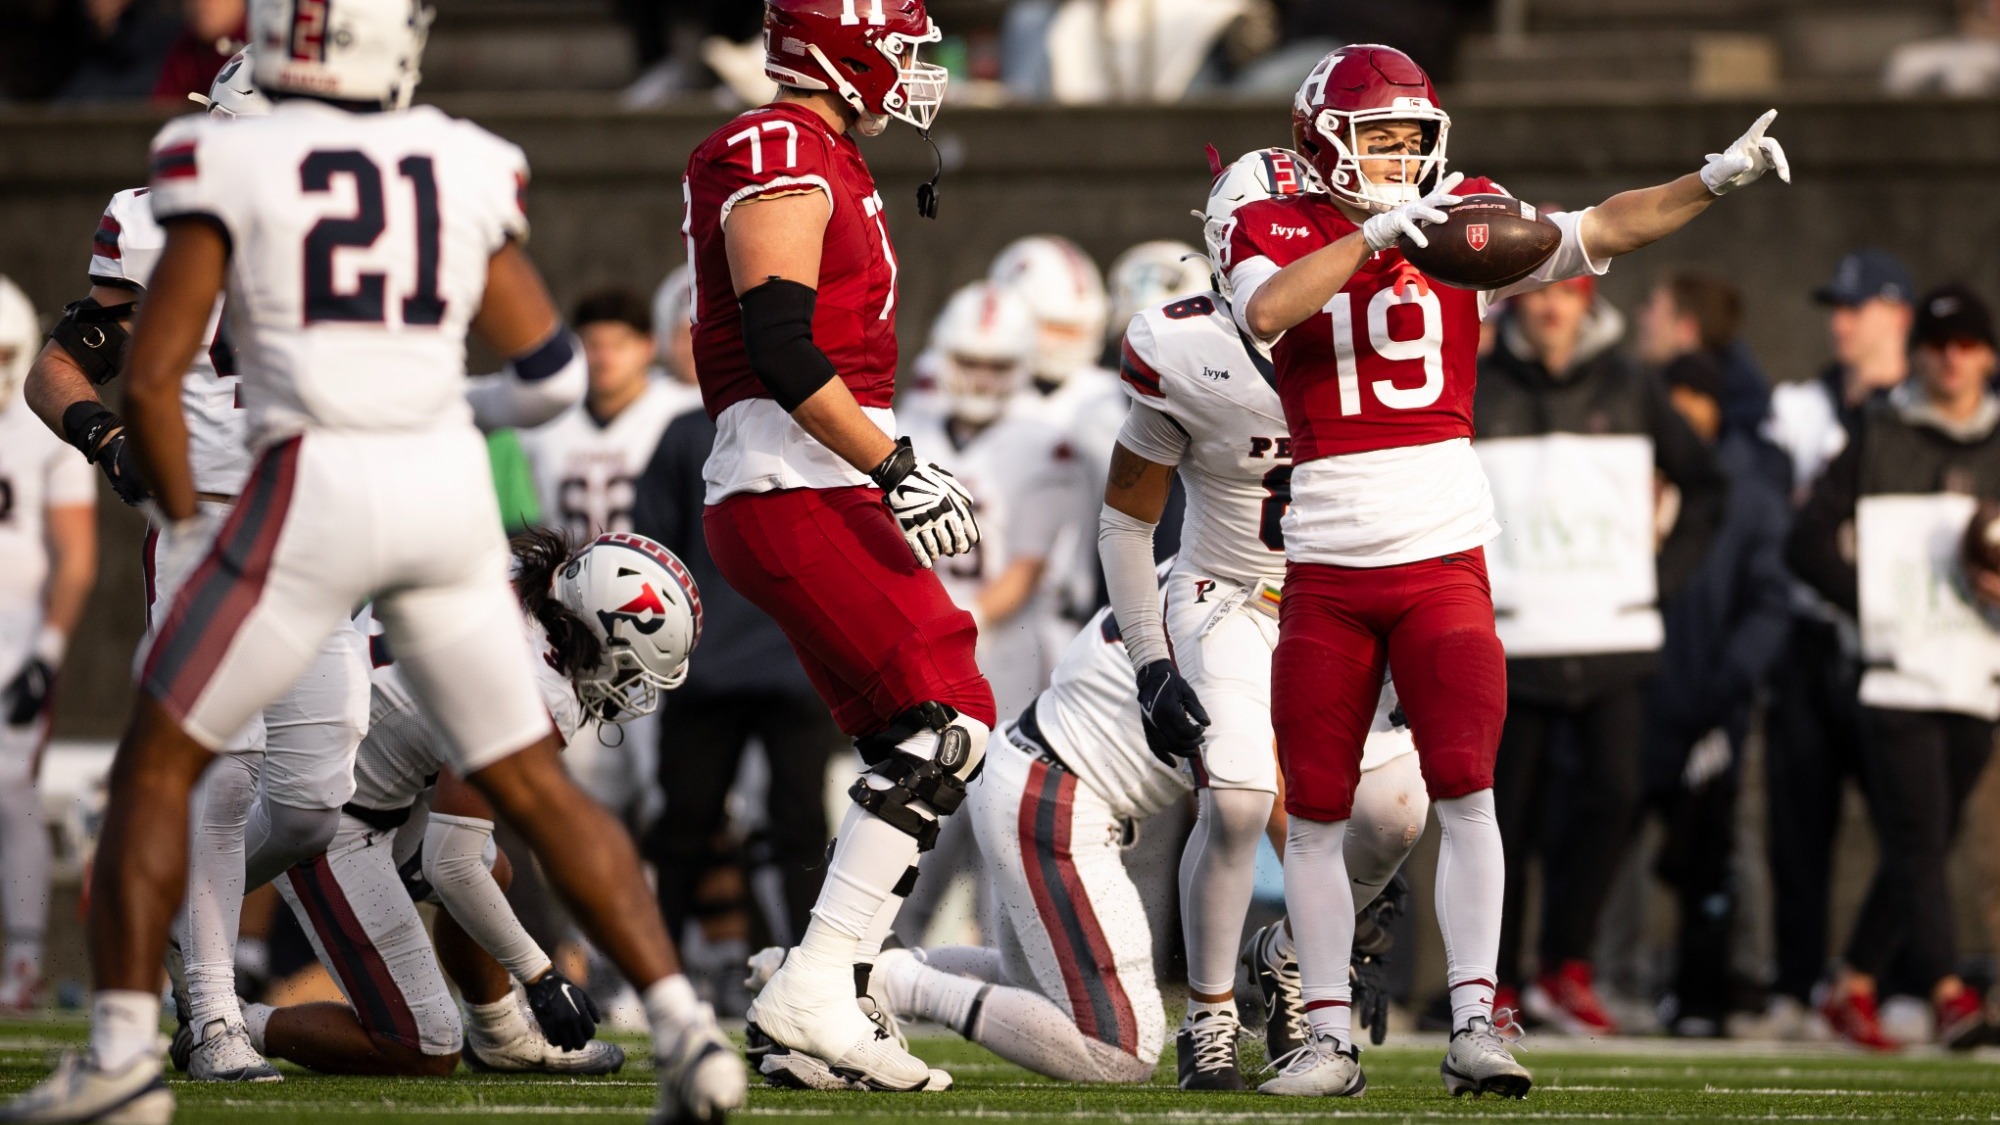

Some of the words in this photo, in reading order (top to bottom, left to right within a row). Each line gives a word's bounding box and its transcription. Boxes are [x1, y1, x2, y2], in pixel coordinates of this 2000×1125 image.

[727, 120, 798, 175] 77
[298, 149, 449, 328] 21
[1270, 223, 1296, 240] Ivy
[1162, 295, 1215, 320] 8
[1322, 284, 1444, 416] 19
[1203, 366, 1221, 380] Ivy
[1248, 436, 1293, 458] PE
